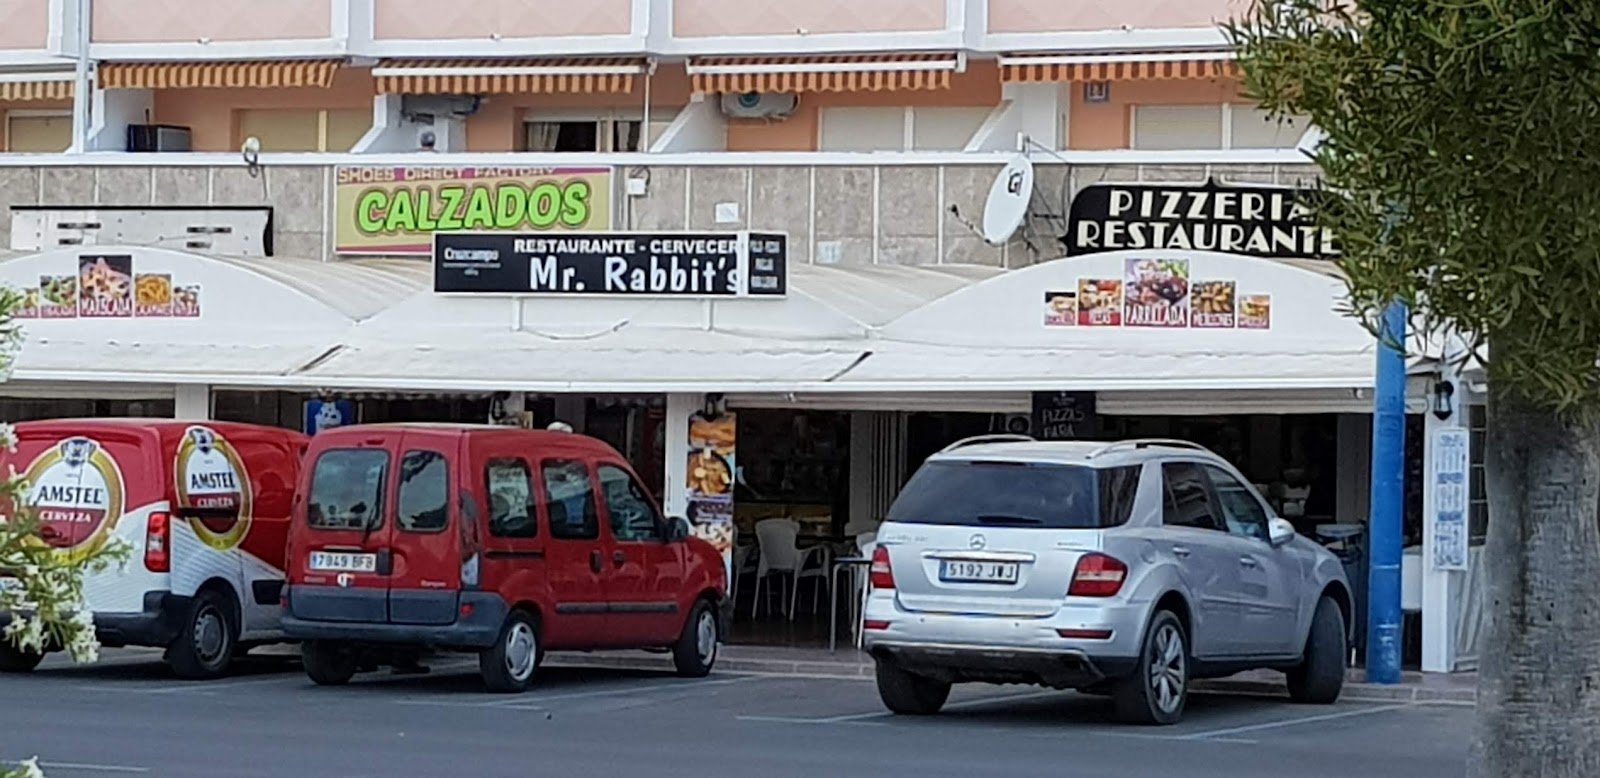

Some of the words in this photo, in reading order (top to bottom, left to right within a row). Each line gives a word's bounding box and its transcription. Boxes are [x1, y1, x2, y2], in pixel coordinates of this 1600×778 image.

[337, 167, 395, 182] SHOES
[403, 167, 464, 181] DIRECT
[357, 181, 590, 233] CALZADOS
[1109, 189, 1314, 221] PIZZERIA
[513, 238, 636, 254] RESTAURANTE
[650, 239, 738, 254] CERVECER
[1076, 220, 1342, 254] RESTAURANTE
[529, 255, 586, 291] Mr.
[604, 255, 738, 292] Rabbit's
[192, 472, 236, 489] AMSTEL
[37, 485, 104, 505] AMSTEL
[39, 510, 92, 523] CERVEZA
[949, 563, 984, 578] 5192
